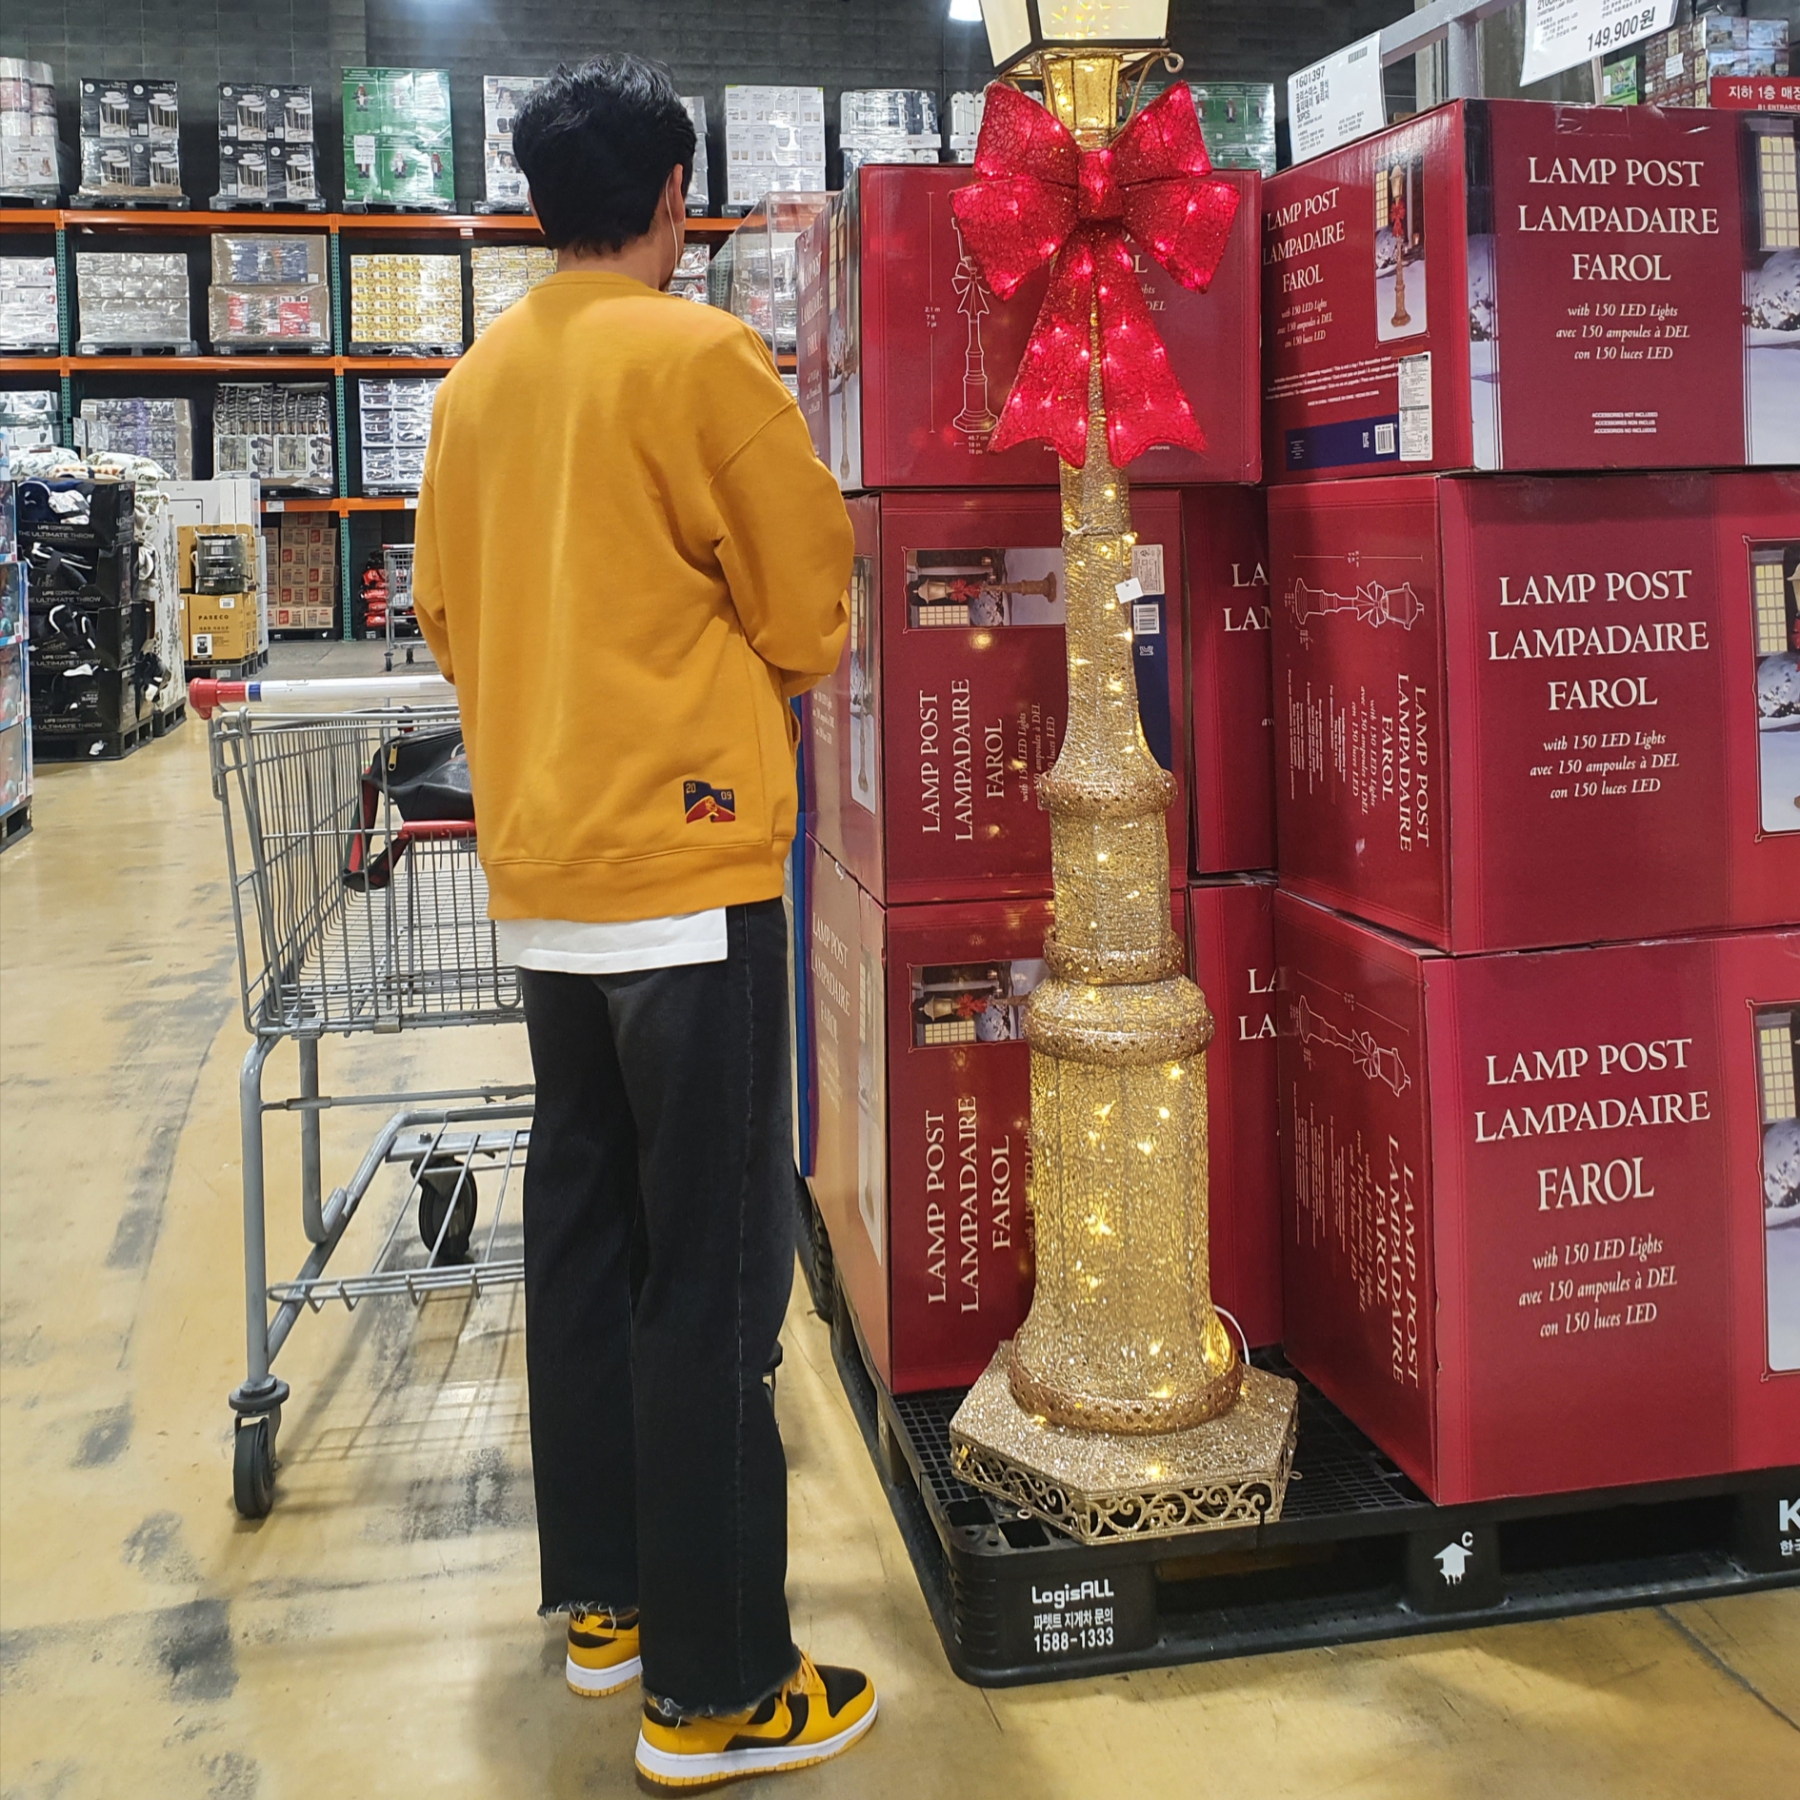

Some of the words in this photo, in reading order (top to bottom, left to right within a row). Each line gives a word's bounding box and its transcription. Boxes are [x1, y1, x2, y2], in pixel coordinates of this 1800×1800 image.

[1587, 6, 1656, 52] 149,900원
[1728, 84, 1754, 100] 지하
[1757, 84, 1777, 100] 1층
[1528, 157, 1617, 185] LAMP
[1625, 159, 1704, 187] POST
[1267, 202, 1302, 232] LAMP
[1304, 187, 1340, 219] POST
[1518, 205, 1720, 235] LAMPADAIRE
[1263, 220, 1346, 266] LAMPADAIRE
[1282, 264, 1324, 294] FAROL
[1572, 254, 1671, 282] FAROL
[1568, 303, 1590, 317] with
[1595, 303, 1616, 317] 150
[1619, 304, 1647, 317] LED
[1650, 303, 1678, 321] Lights
[1556, 328, 1576, 338] avec
[1582, 325, 1603, 338] 150
[1606, 326, 1651, 342] ampoules
[1654, 326, 1661, 338] à
[1664, 325, 1691, 338] DEL
[1574, 349, 1590, 360] con
[1596, 346, 1616, 360] 150
[1620, 347, 1643, 360] luces
[1647, 346, 1673, 360] LED
[31, 531, 69, 539] ULTIMATE
[1499, 573, 1596, 606] LAMP
[1605, 569, 1692, 601] POST
[1488, 621, 1710, 661] LAMPADAIRE
[1547, 677, 1658, 711] FAROL
[919, 690, 939, 756] POST
[1017, 712, 1030, 736] Lights
[1415, 685, 1428, 766] LAMP
[1543, 736, 1568, 751] with
[1573, 735, 1597, 749] 150
[1601, 733, 1631, 748] LED
[1634, 730, 1666, 750] Lights
[951, 678, 974, 842] LAMPADAIRE
[984, 718, 1005, 799] FAROL
[1018, 738, 1028, 760] LED
[1382, 715, 1394, 801] FAROL
[1398, 673, 1412, 852] LAMPADAIRE
[1530, 765, 1552, 777] avec
[1558, 759, 1582, 775] 150
[1586, 755, 1636, 776] ampoules
[1639, 756, 1647, 769] à
[1651, 753, 1680, 769] DEL
[686, 783, 697, 794] 20
[720, 791, 733, 800] 09
[920, 761, 941, 833] LAMP
[1018, 783, 1029, 802] with
[1550, 787, 1568, 799] con
[1574, 783, 1597, 798] 150
[1602, 780, 1627, 796] luces
[1631, 778, 1661, 794] LED
[1416, 772, 1429, 848] POST
[812, 911, 830, 949] LAMP
[830, 933, 849, 970] POST
[811, 949, 851, 1018] LAMPADAIRE
[820, 999, 839, 1045] FAROL
[1486, 1047, 1589, 1086] LAMP
[1598, 1038, 1692, 1075] POST
[1474, 1091, 1711, 1143] LAMPADAIRE
[925, 1109, 945, 1194] POST
[957, 1095, 980, 1314] LAMPADAIRE
[991, 1134, 1011, 1250] FAROL
[1537, 1156, 1655, 1212] FAROL
[1404, 1162, 1416, 1282] LAMP
[927, 1202, 946, 1304] LAMP
[1375, 1183, 1387, 1305] FAROL
[1388, 1134, 1404, 1385] LAMPADAIRE
[1533, 1247, 1558, 1270] with
[1564, 1243, 1589, 1266] 150
[1593, 1238, 1625, 1262] LED
[1629, 1233, 1663, 1262] Lights
[1519, 1289, 1543, 1306] avec
[1549, 1279, 1574, 1302] 150
[1578, 1271, 1631, 1303] ampoules
[1634, 1271, 1642, 1290] à
[1647, 1265, 1677, 1289] DEL
[1406, 1287, 1419, 1389] POST
[1540, 1320, 1559, 1338] con
[1565, 1311, 1589, 1334] 150
[1594, 1306, 1621, 1330] luces
[1626, 1302, 1657, 1326] LED
[1461, 1531, 1474, 1547] C
[1031, 1578, 1115, 1610] LogisALL
[1033, 1612, 1063, 1632] 파렛트
[1064, 1608, 1093, 1630] 지게차
[1094, 1606, 1114, 1626] 문의
[1034, 1626, 1114, 1653] 1588-1333
